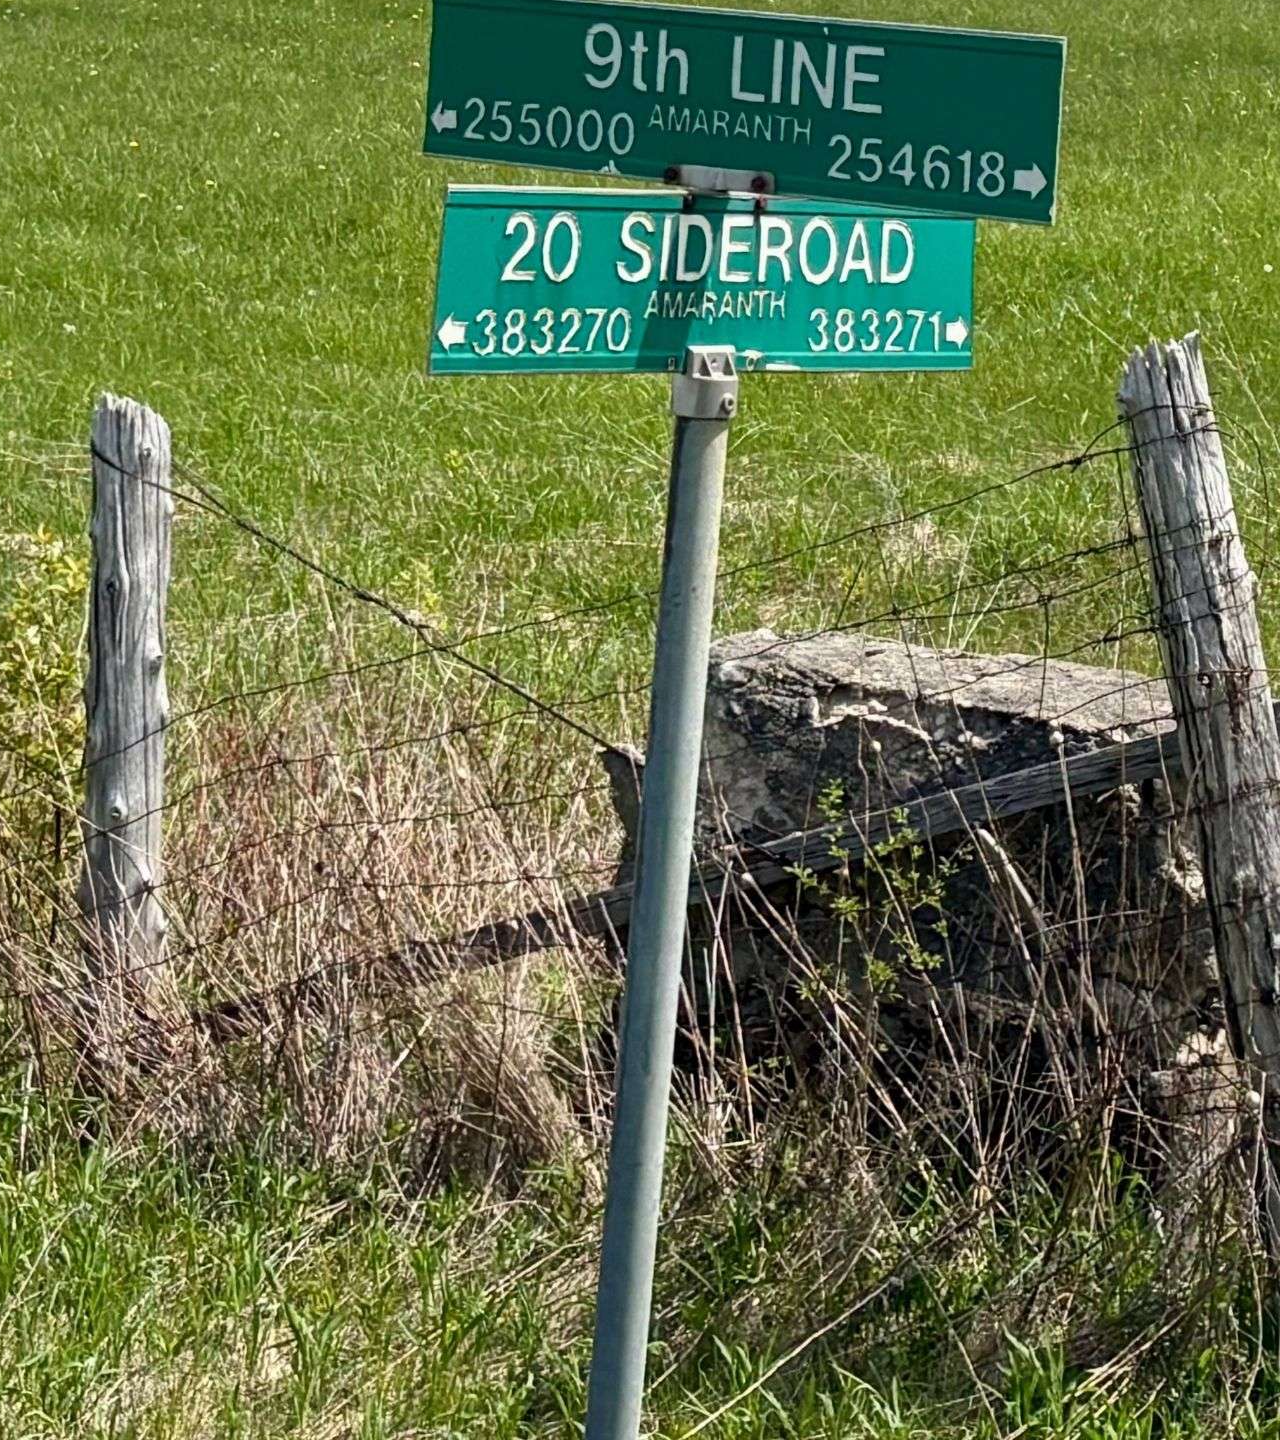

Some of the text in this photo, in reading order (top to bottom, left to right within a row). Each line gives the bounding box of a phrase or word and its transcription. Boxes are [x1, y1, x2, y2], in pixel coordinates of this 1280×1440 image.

[584, 21, 887, 115] 9th LINE
[463, 97, 635, 156] 255000
[648, 104, 812, 145] AMARANTH
[827, 134, 1006, 198] 254618
[501, 210, 916, 285] 20 SIDEROAD
[643, 289, 787, 320] AMARANTH
[808, 308, 942, 354] 383271
[472, 308, 632, 356] 383270
